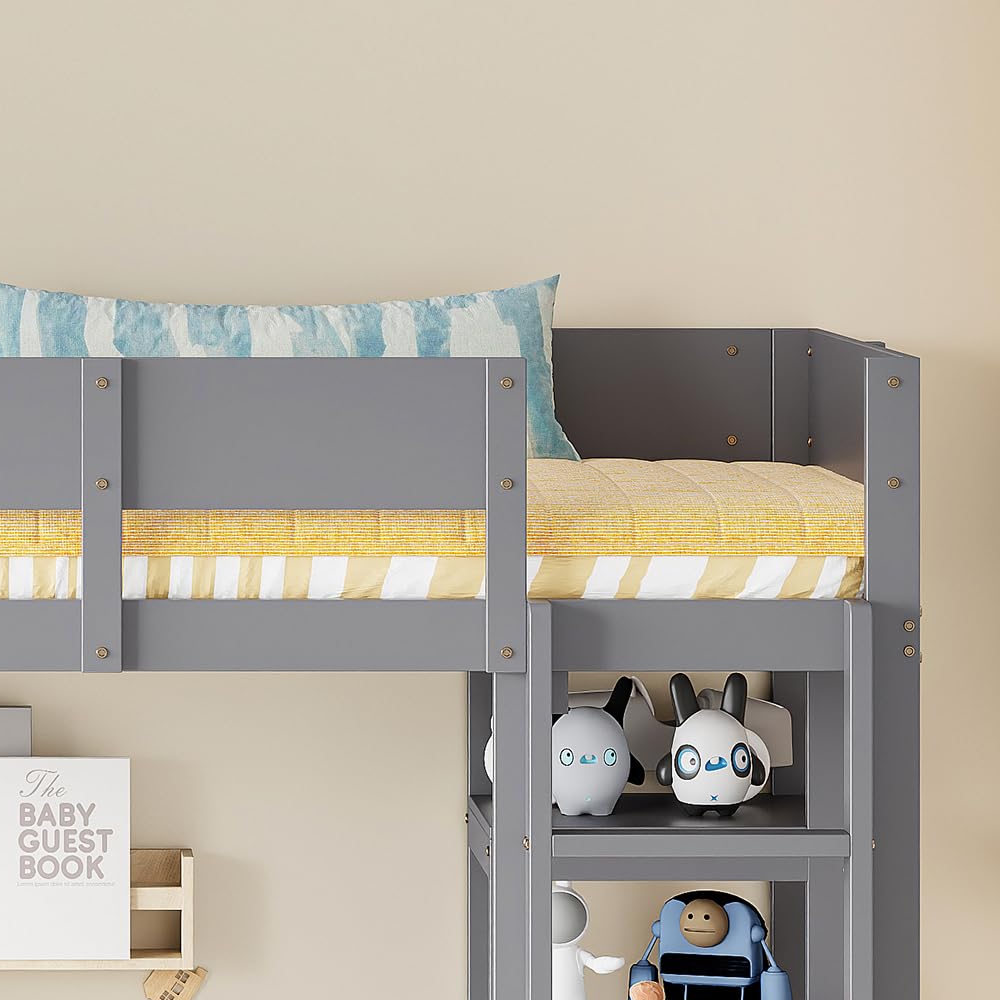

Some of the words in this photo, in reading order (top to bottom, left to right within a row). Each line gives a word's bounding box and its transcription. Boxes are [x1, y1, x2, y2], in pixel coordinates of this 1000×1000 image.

[19, 769, 67, 798] The
[19, 802, 96, 827] BABY
[18, 829, 114, 853] GUEST
[19, 855, 105, 880] BOOK
